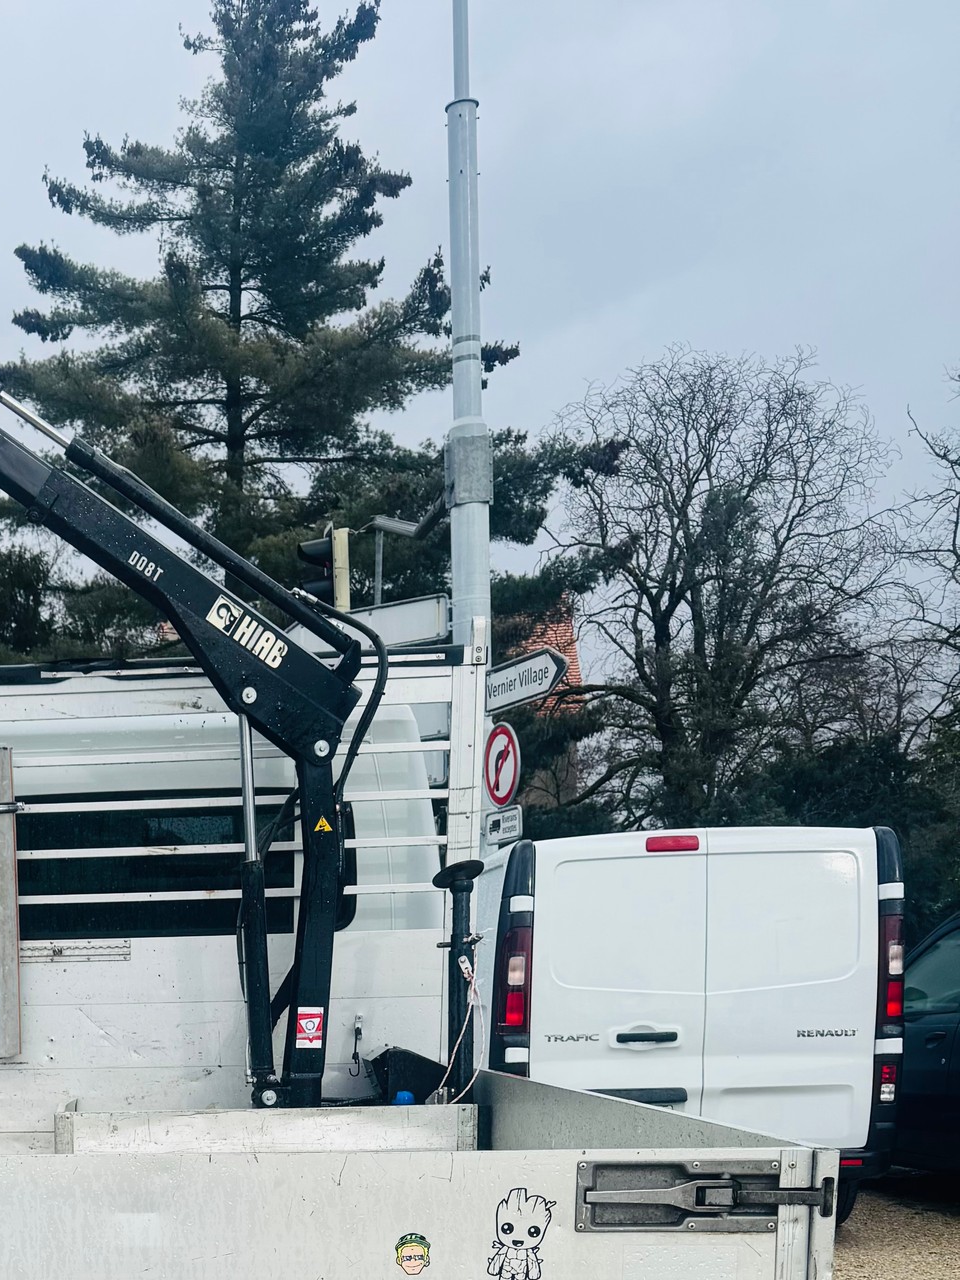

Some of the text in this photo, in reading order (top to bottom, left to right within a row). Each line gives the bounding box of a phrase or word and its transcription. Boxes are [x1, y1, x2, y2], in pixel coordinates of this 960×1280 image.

[232, 615, 289, 669] HIAB
[487, 666, 549, 699] Vernier Village
[544, 1033, 600, 1042] TRAFIC
[796, 1028, 859, 1038] RENAULT
